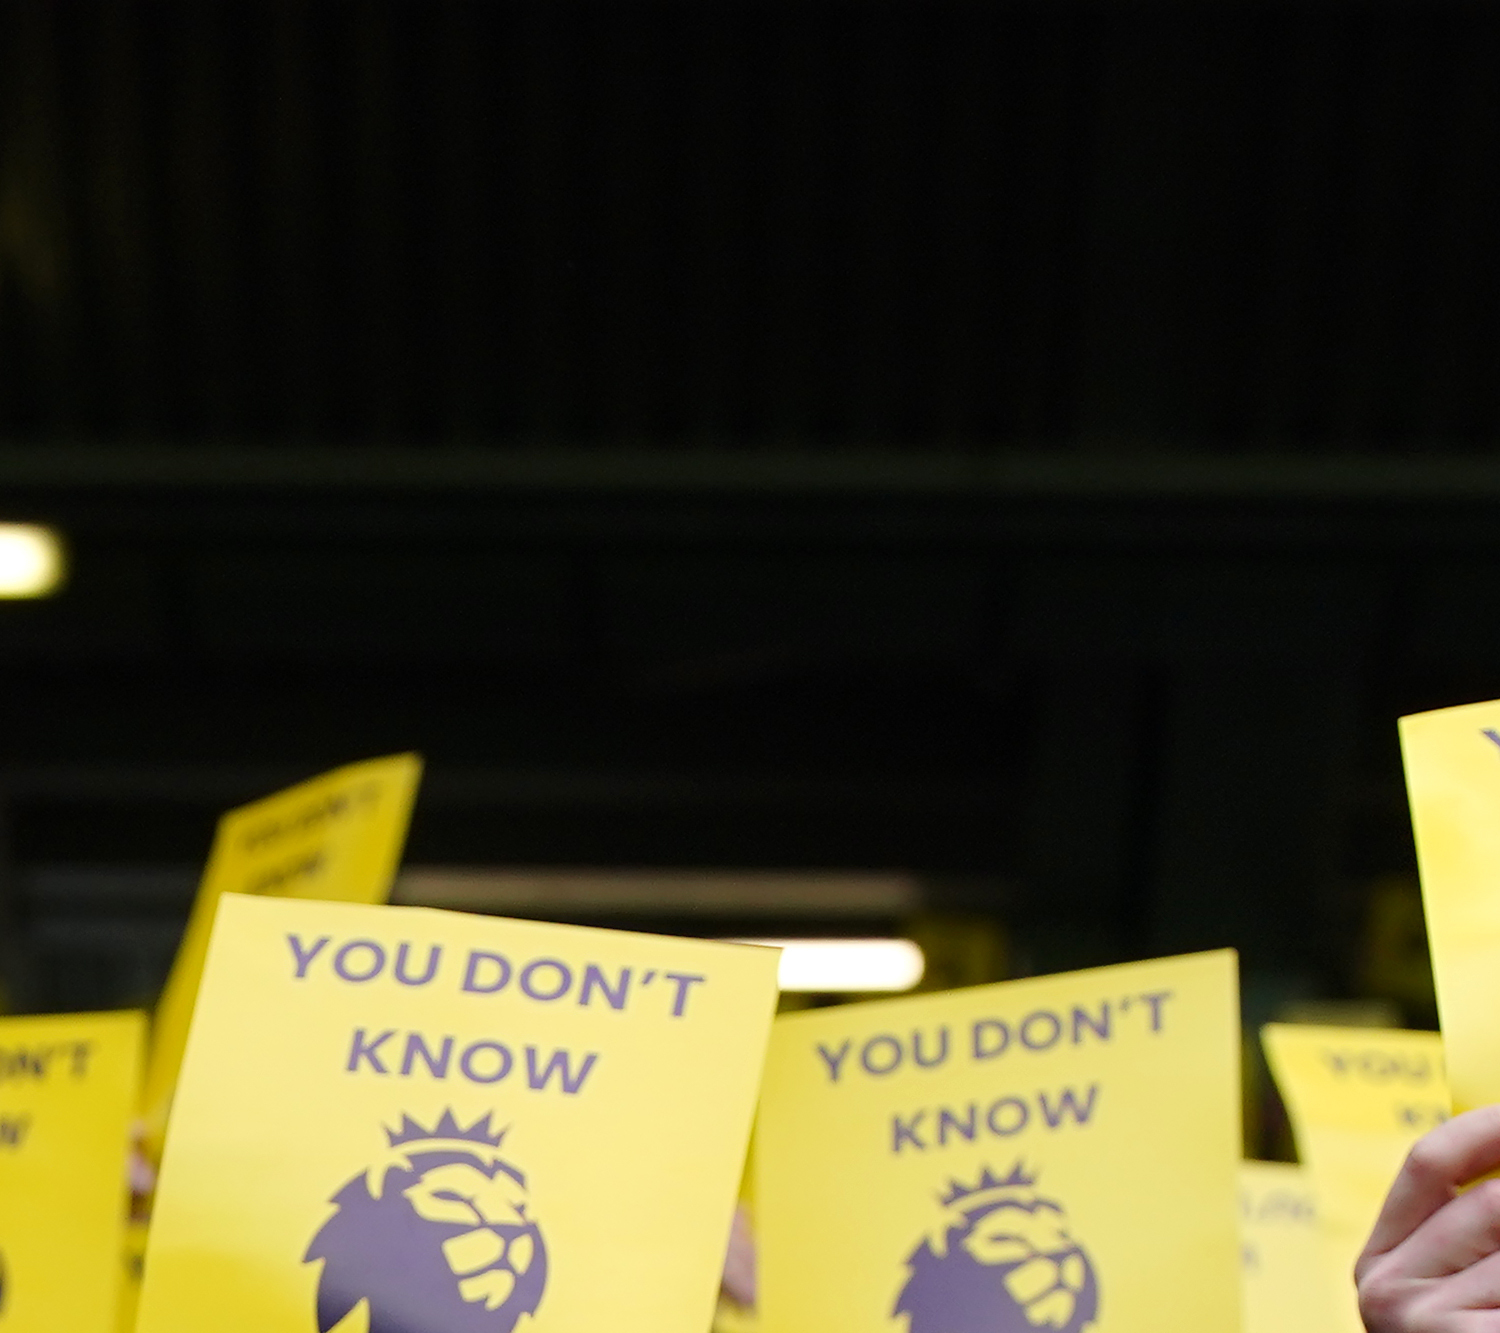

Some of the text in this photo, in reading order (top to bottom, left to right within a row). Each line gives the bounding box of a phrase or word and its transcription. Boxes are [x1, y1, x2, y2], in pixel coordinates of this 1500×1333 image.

[288, 935, 705, 1016] YOU DON'T
[346, 1029, 597, 1094] KNOW
[817, 991, 1174, 1082] YOU DON'T
[892, 1085, 1097, 1153] KNOW
